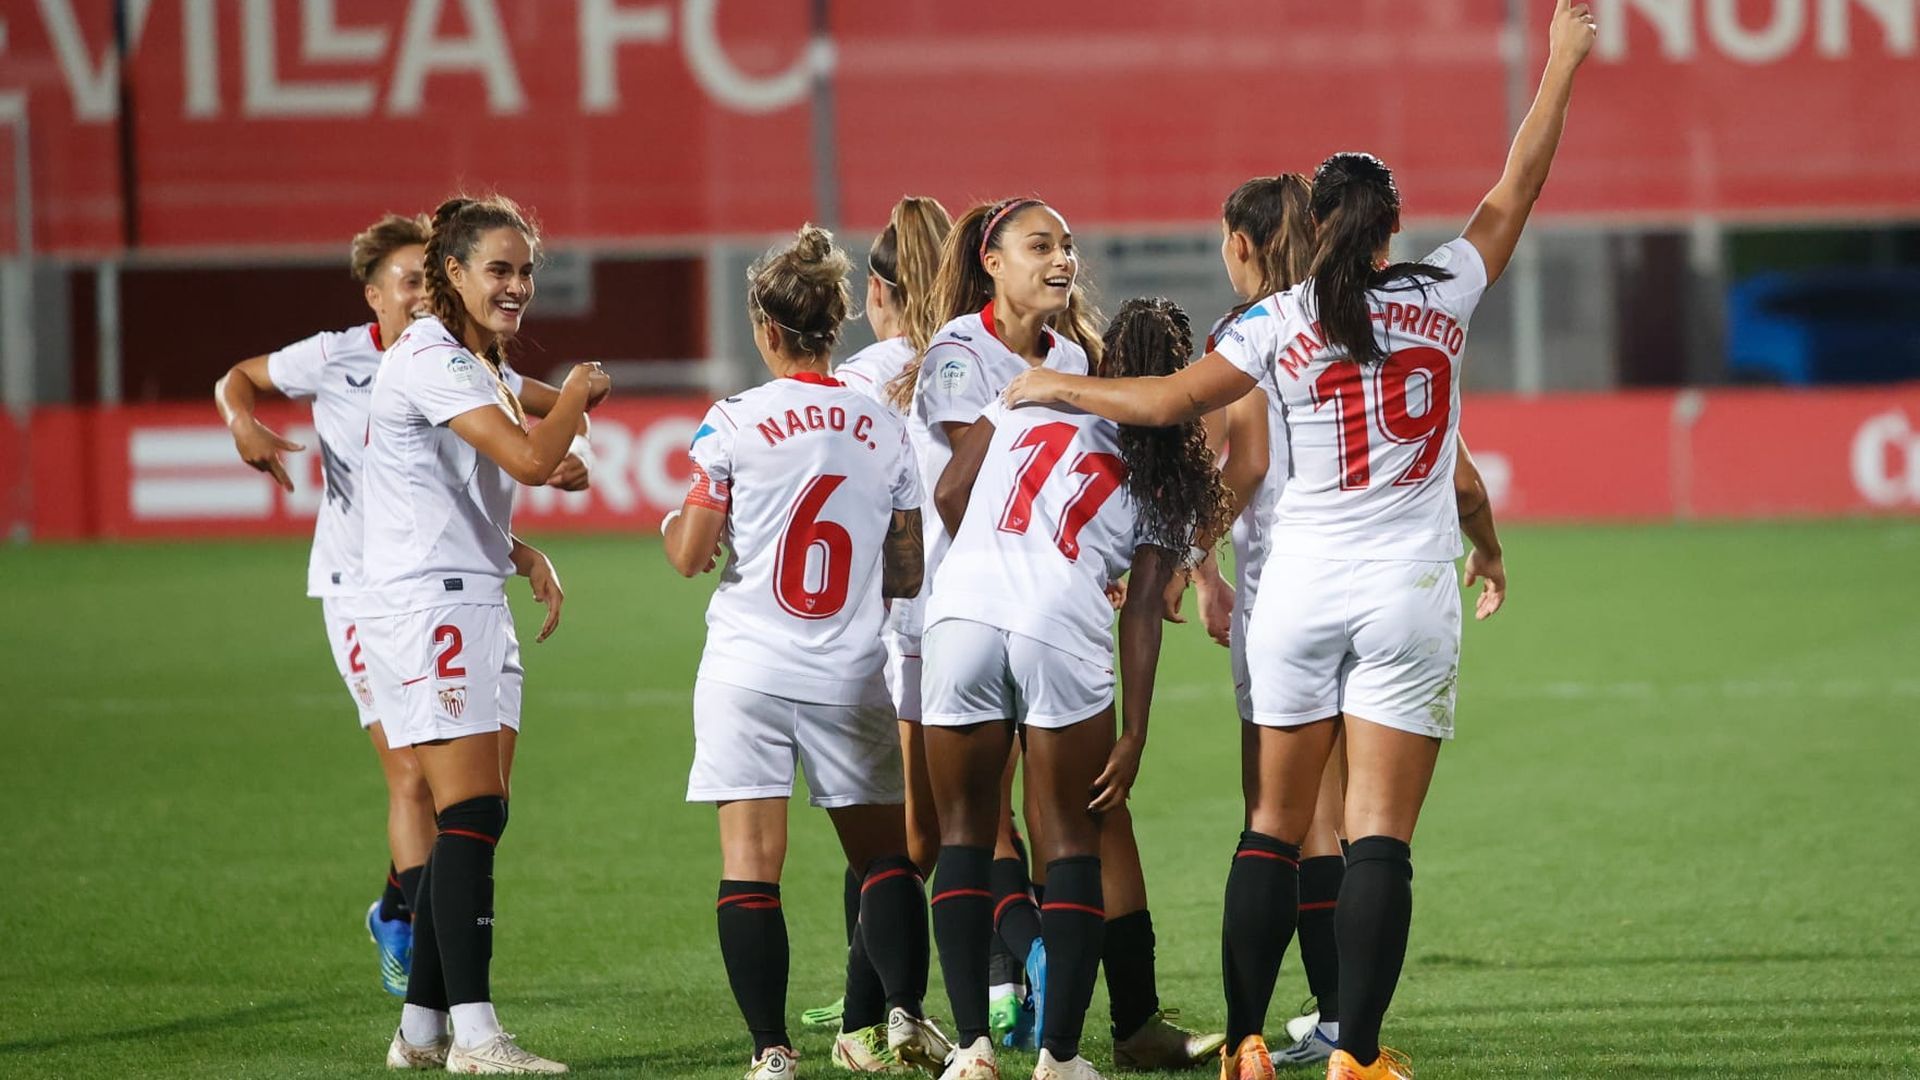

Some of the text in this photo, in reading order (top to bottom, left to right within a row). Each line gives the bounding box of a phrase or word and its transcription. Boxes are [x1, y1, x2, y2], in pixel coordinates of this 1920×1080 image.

[756, 405, 878, 450] NAGO C.
[1308, 346, 1452, 492] 19
[772, 474, 853, 620] 6
[432, 624, 466, 680] 2
